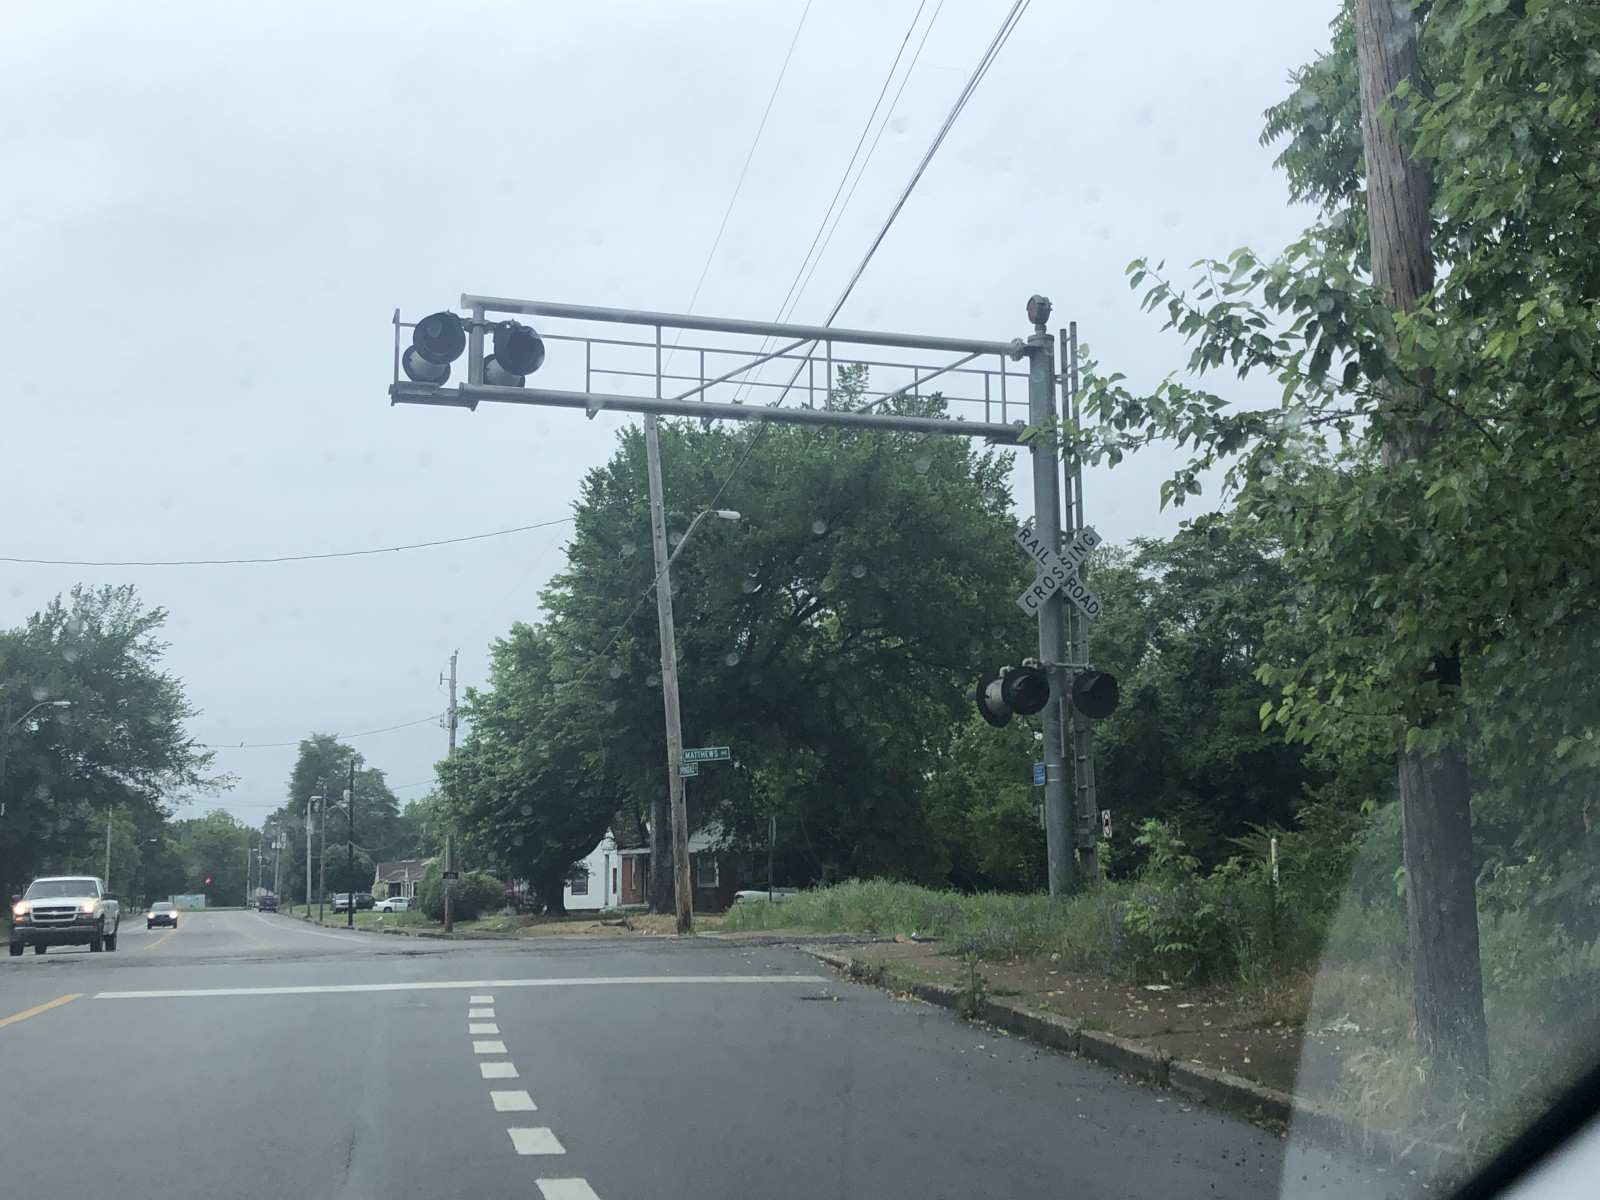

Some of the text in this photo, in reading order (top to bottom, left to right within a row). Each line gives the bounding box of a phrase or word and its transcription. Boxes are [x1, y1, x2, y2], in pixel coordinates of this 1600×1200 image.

[1018, 527, 1099, 614] RAIL ROAD
[1025, 533, 1095, 609] CROSSING
[684, 749, 719, 760] MATTHEWS
